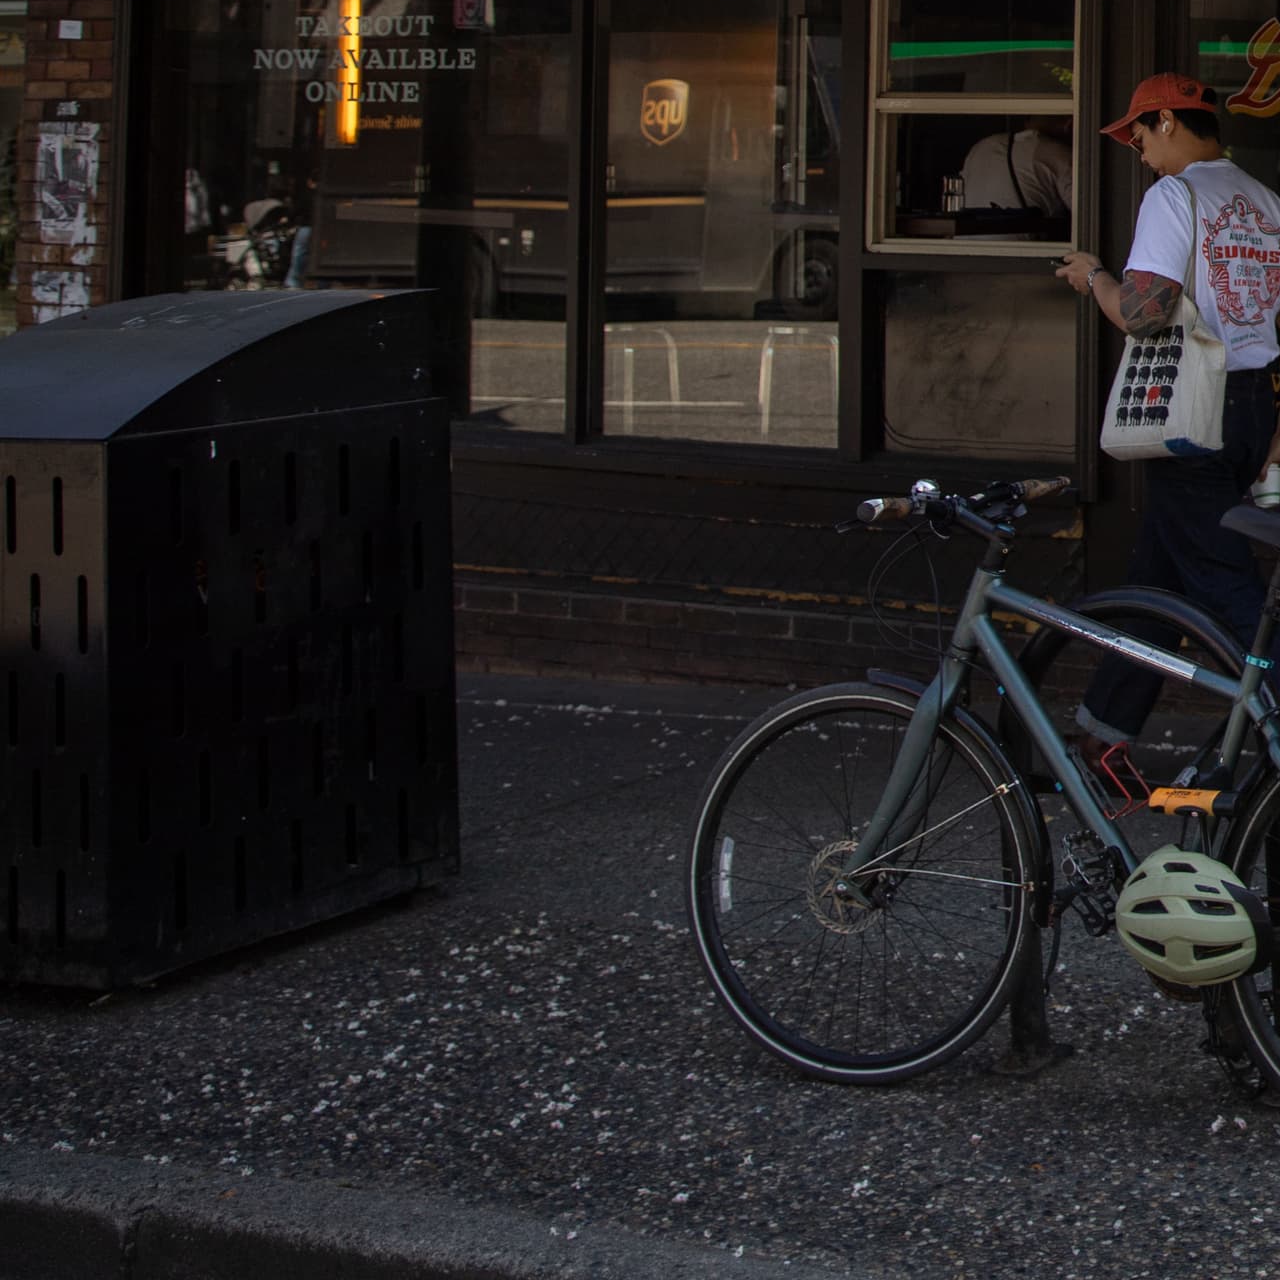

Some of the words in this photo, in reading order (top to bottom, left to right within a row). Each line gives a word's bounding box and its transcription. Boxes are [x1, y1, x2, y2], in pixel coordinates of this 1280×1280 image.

[295, 14, 436, 38] TAKEOUT
[252, 47, 321, 70] NOW
[328, 47, 478, 70] AVAILBLE
[304, 80, 422, 103] ONLINE
